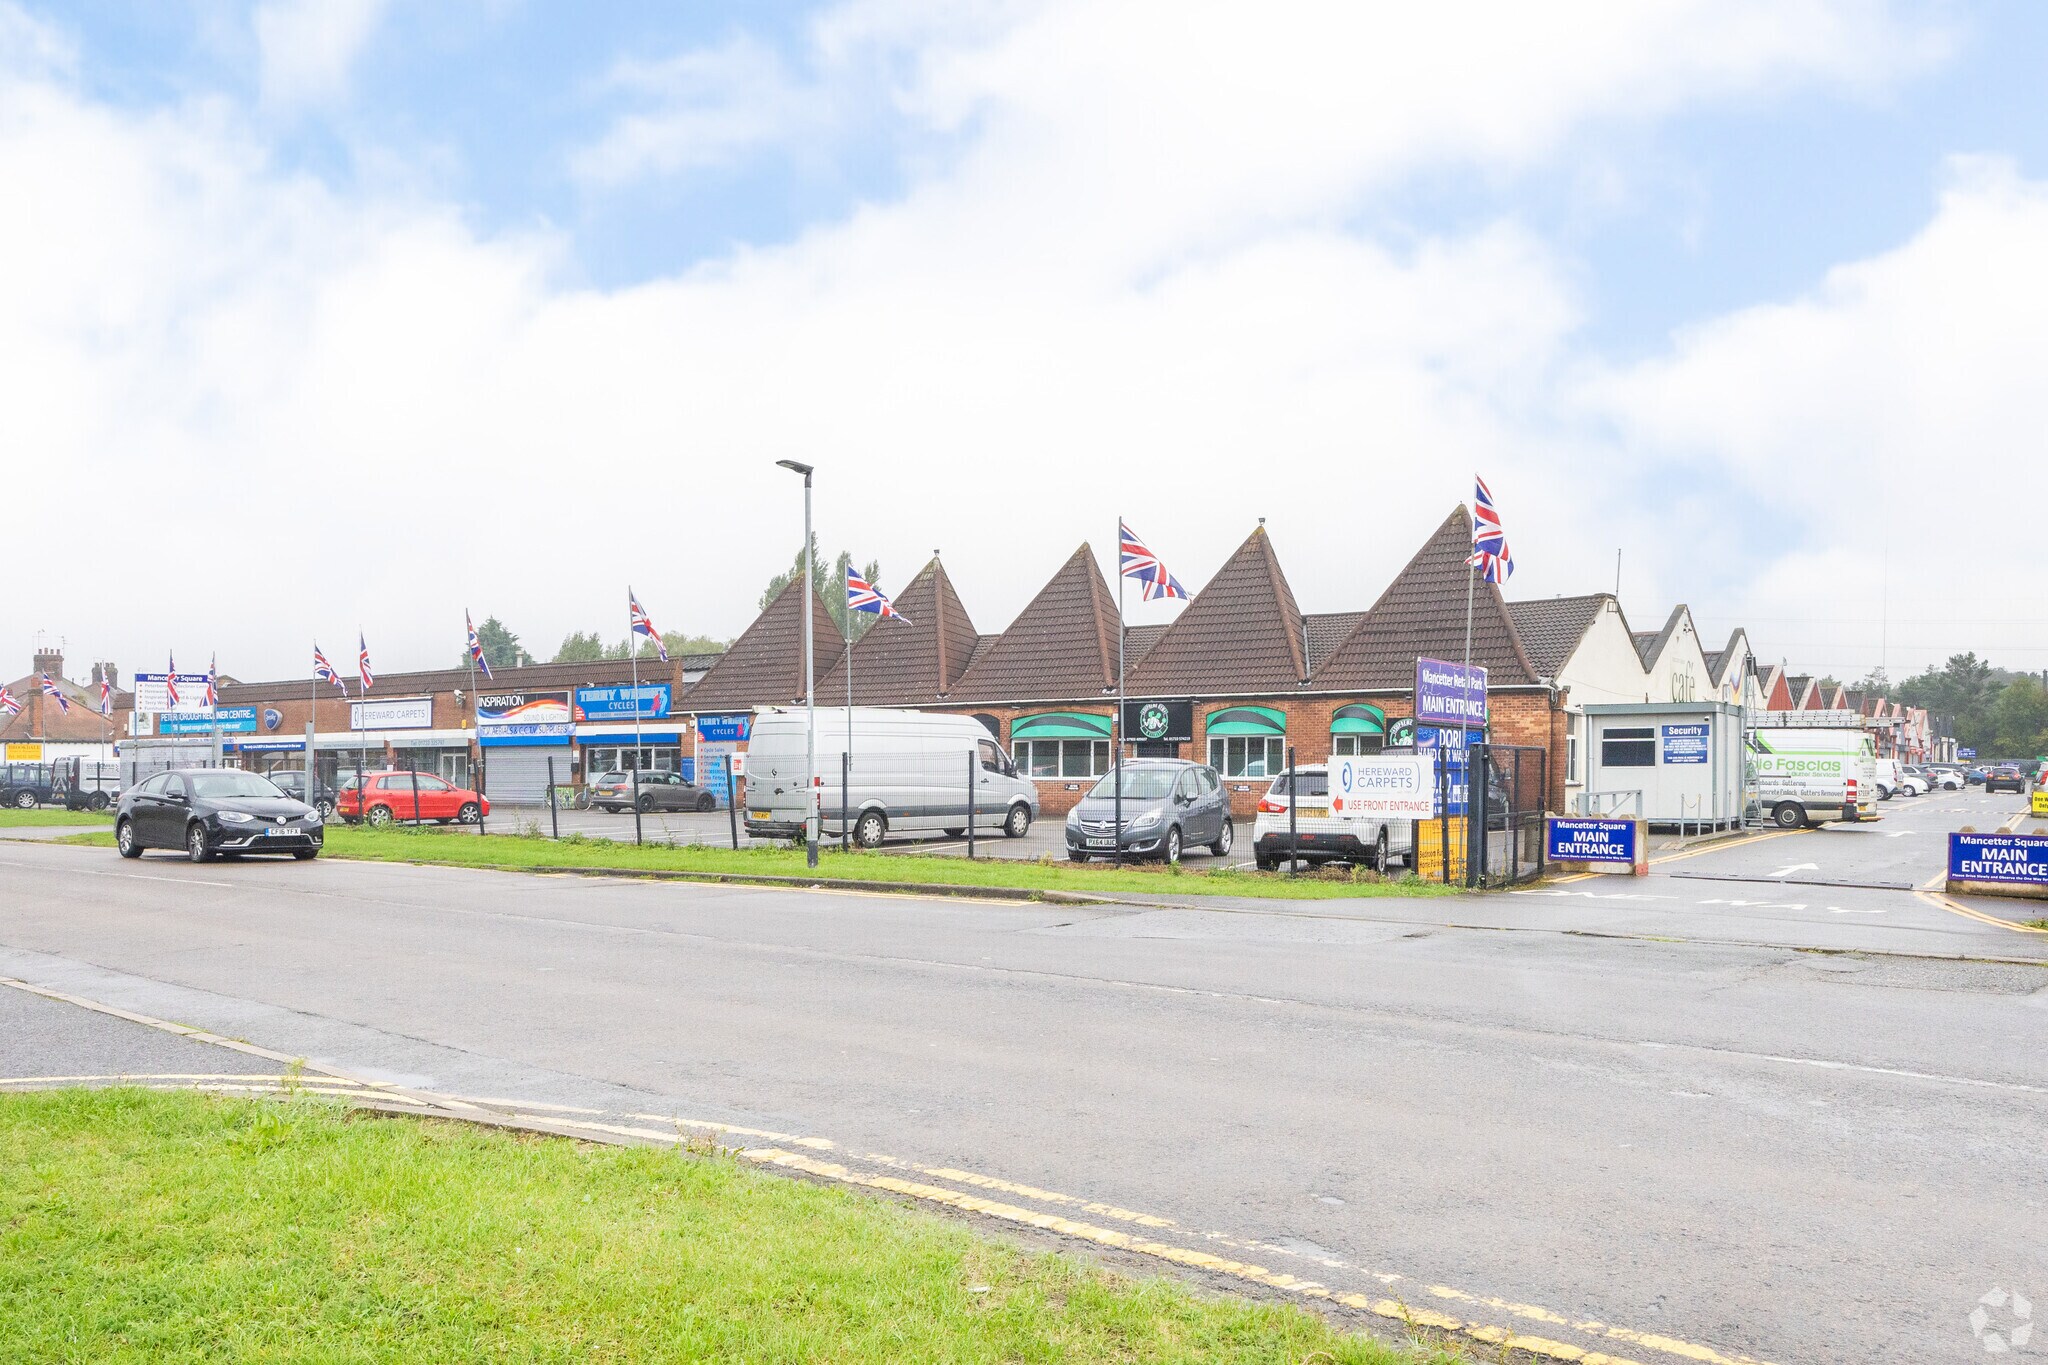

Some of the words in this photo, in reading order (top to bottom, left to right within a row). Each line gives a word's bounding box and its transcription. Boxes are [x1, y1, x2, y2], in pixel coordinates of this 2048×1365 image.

[1423, 669, 1454, 687] Mancetter
[1454, 674, 1470, 688] Retal
[1471, 678, 1483, 690] Park
[479, 695, 525, 707] INSPIRATION
[580, 689, 618, 702] TERRY
[608, 701, 635, 710] CYCLES
[1423, 695, 1445, 714] MAIN
[1446, 698, 1483, 718] ENTRANCE
[161, 711, 202, 723] PETEROROUGH
[203, 710, 227, 720] RECNER
[229, 709, 251, 719] CENTRE
[396, 709, 426, 719] CARPETS
[546, 713, 568, 721] LIGHTING
[700, 717, 720, 726] TERRY
[1668, 726, 1703, 736] Security
[1439, 728, 1462, 749] DORI
[1438, 748, 1451, 762] CR
[1452, 749, 1470, 763] WAH
[1776, 758, 1841, 772] Fascias
[1358, 767, 1412, 777] HEREWARD
[1357, 777, 1413, 789] CARPETS
[1820, 789, 1844, 797] Removed
[1348, 800, 1361, 811] USE
[1362, 800, 1388, 811] FRONT
[1389, 801, 1430, 812] ENTRANCE
[1557, 821, 1597, 830] Mancetter
[1598, 822, 1627, 832] Square
[1573, 831, 1609, 843] MAIN
[1960, 836, 2013, 846] Mancetter
[1557, 842, 1625, 856] ENTRANCE
[1982, 848, 2028, 862] MAIN
[1961, 860, 2047, 876] ENTRANCE
